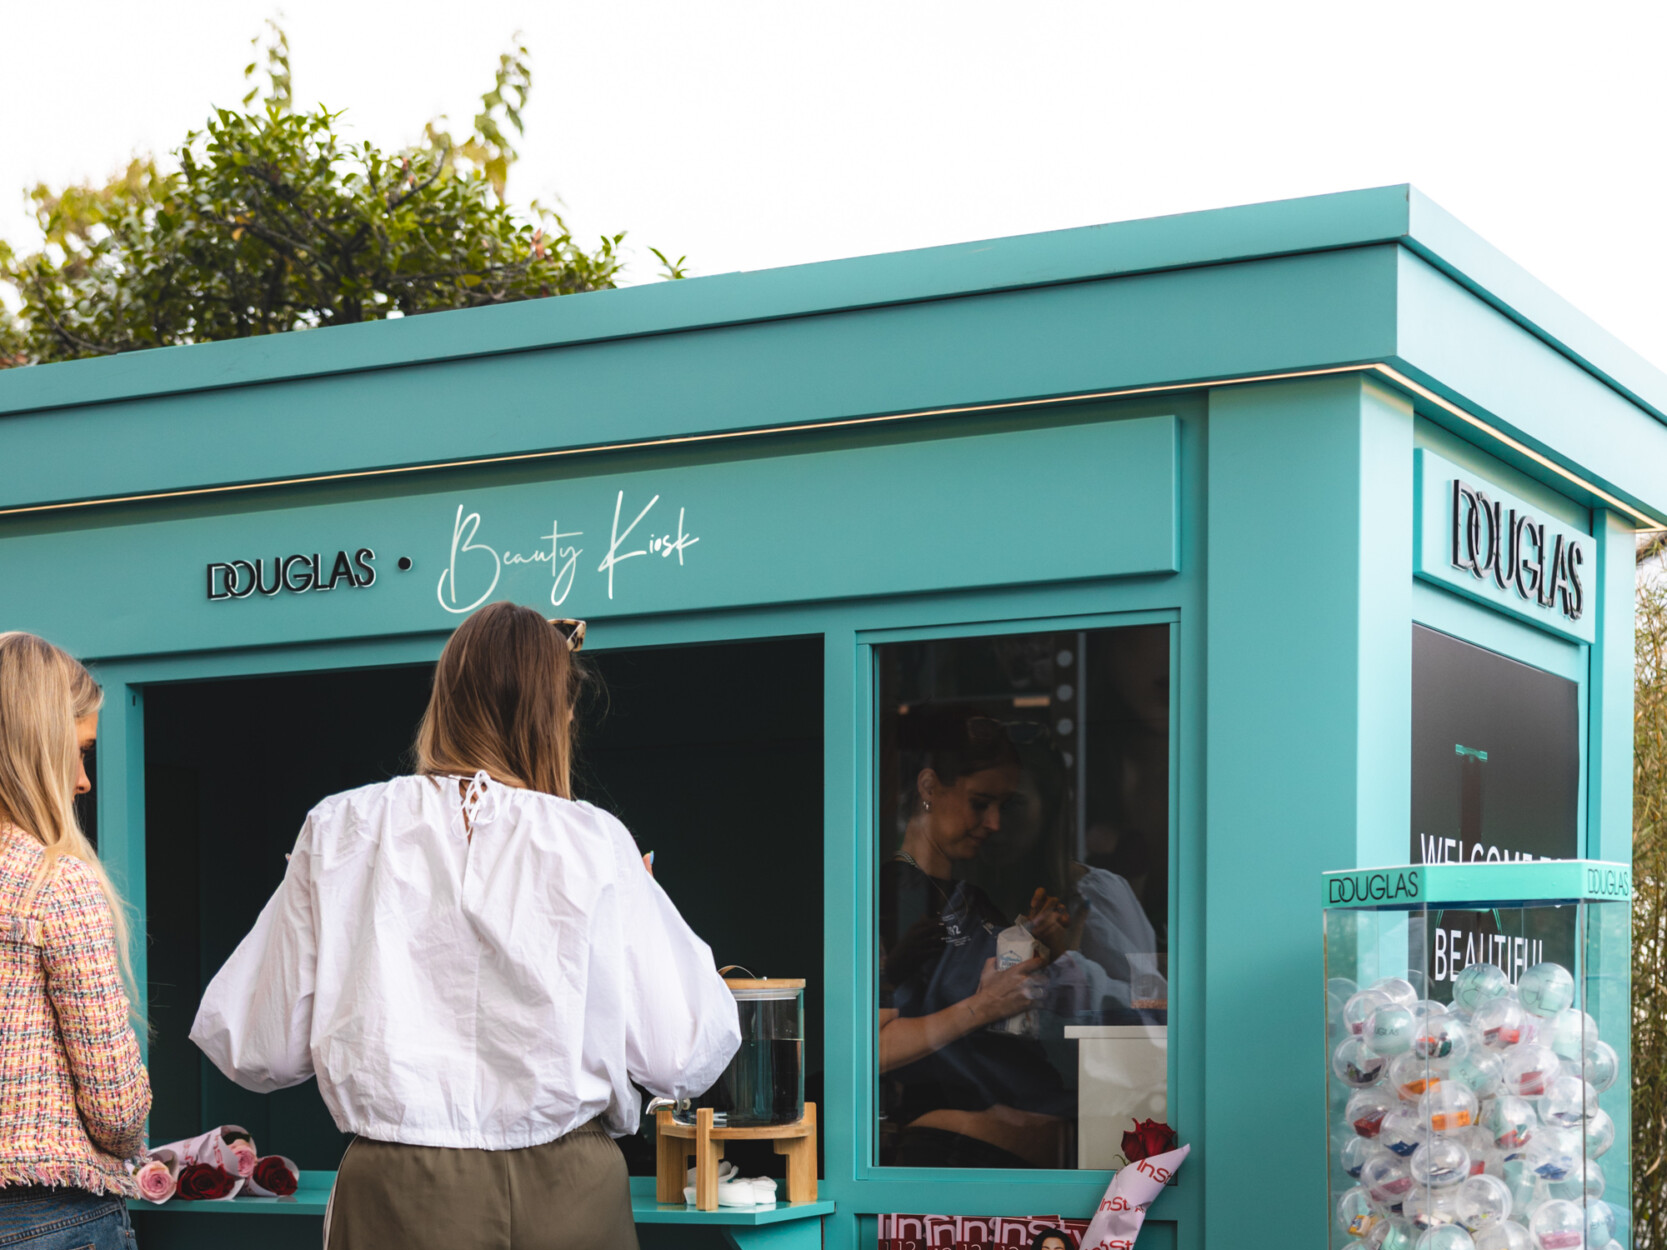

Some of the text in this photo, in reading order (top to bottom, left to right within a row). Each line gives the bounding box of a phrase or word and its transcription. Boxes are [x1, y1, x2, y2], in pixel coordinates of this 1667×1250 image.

[206, 490, 699, 613] DOUGLAS Beauty Kiosk
[1451, 479, 1584, 622] DOUGLAS
[1329, 871, 1418, 904] DOUGLAS
[1588, 868, 1630, 896] DOUGLAS
